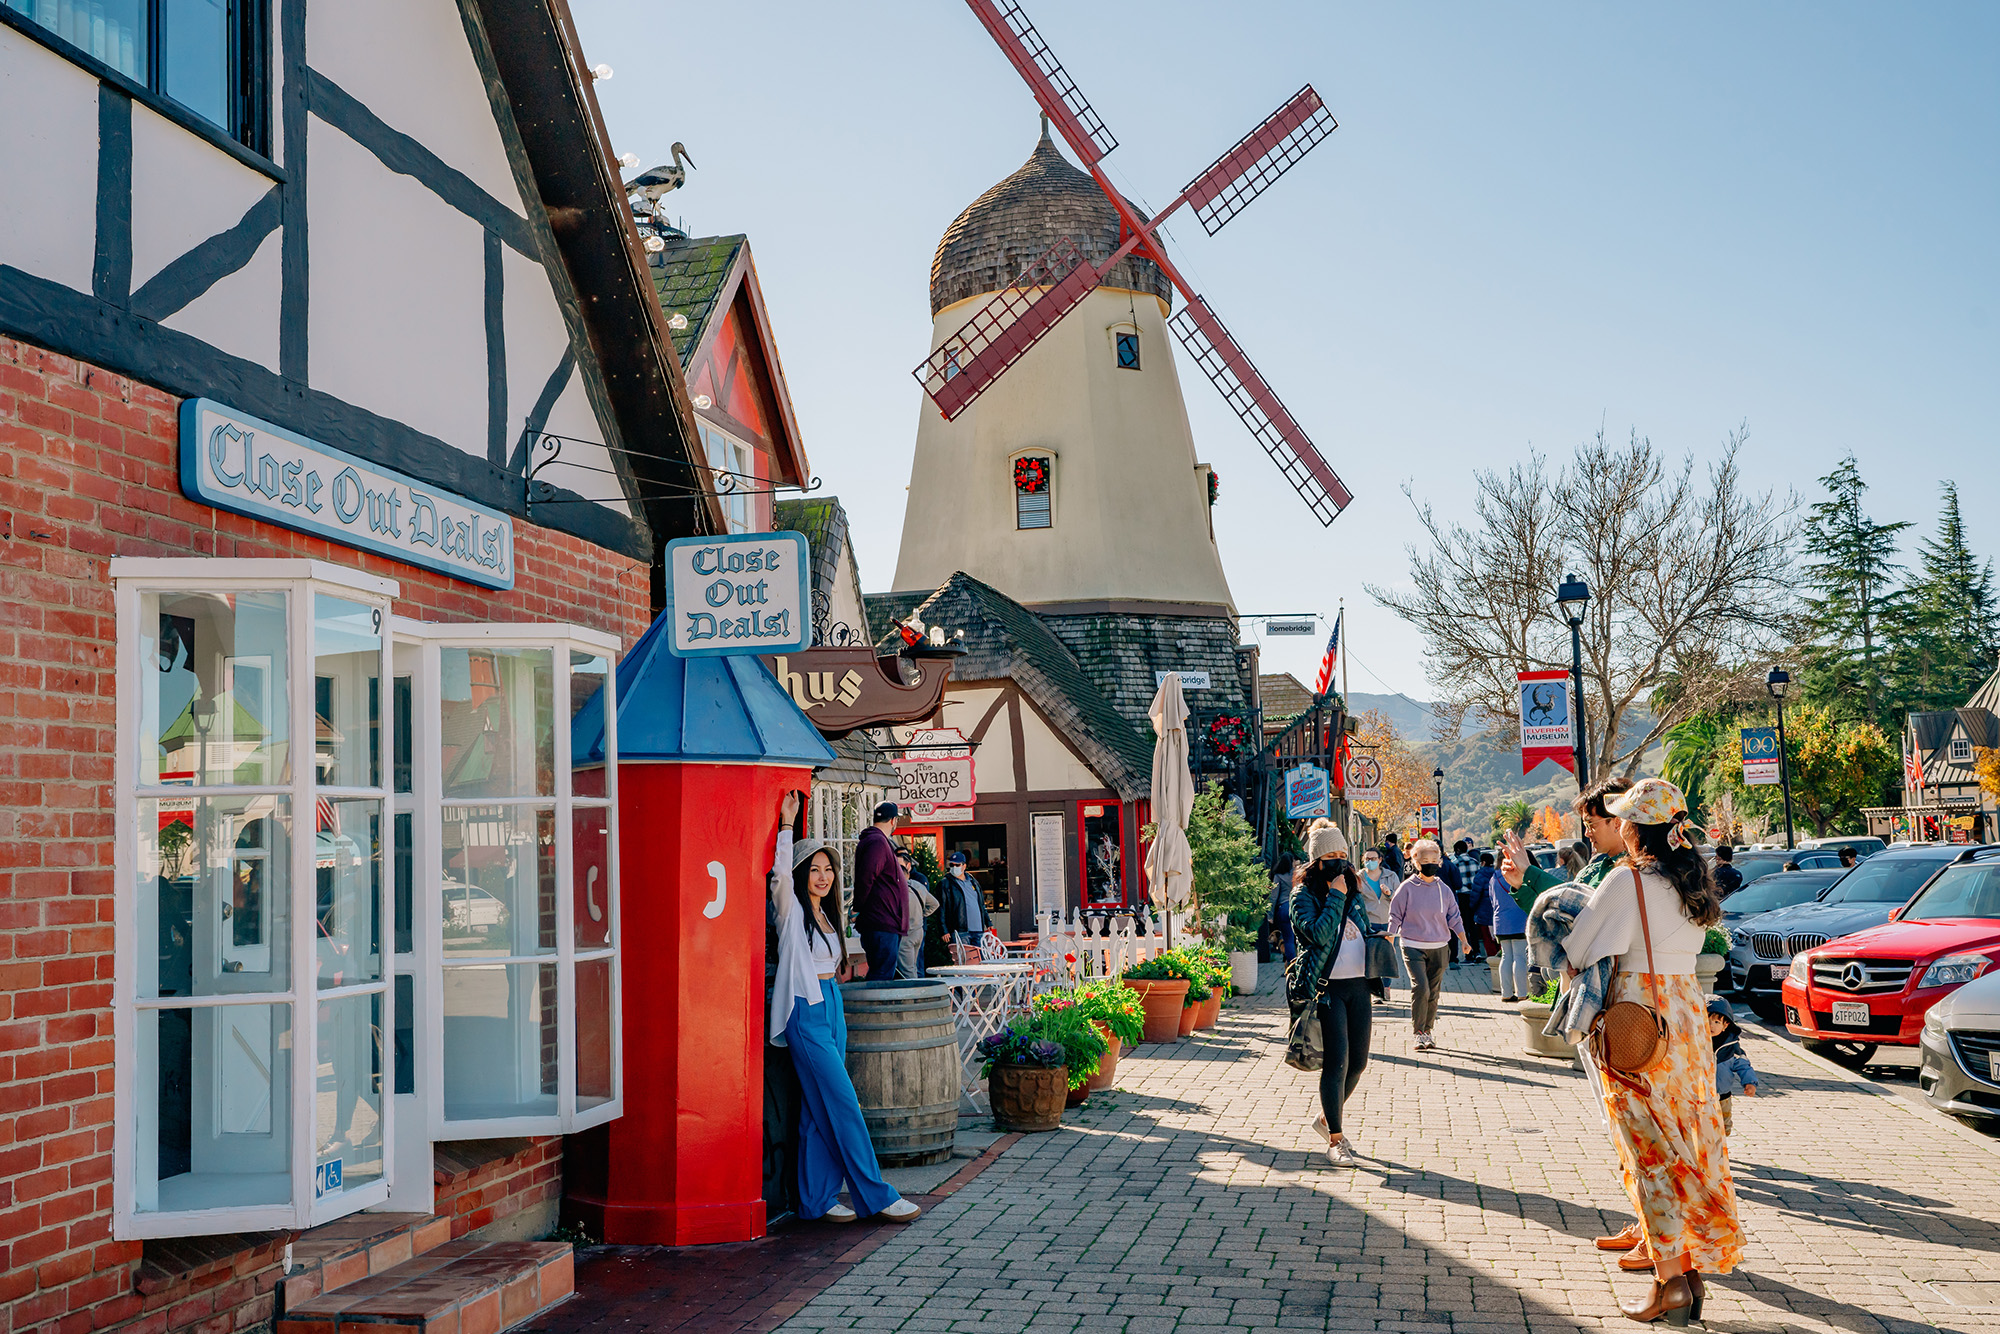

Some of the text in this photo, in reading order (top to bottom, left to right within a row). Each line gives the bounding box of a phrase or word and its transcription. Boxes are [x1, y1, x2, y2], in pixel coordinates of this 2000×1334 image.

[209, 423, 506, 574] Close Out Deals!
[692, 547, 780, 575] Close
[705, 578, 768, 608] Out
[372, 609, 382, 635] 9
[686, 608, 791, 643] Deals!
[1744, 736, 1775, 754] 100
[917, 763, 933, 771] The
[900, 785, 950, 802] Bakery
[1292, 779, 1322, 794] Tower
[1291, 790, 1325, 807] Pizza
[1835, 1010, 1867, 1023] 6TFP022
